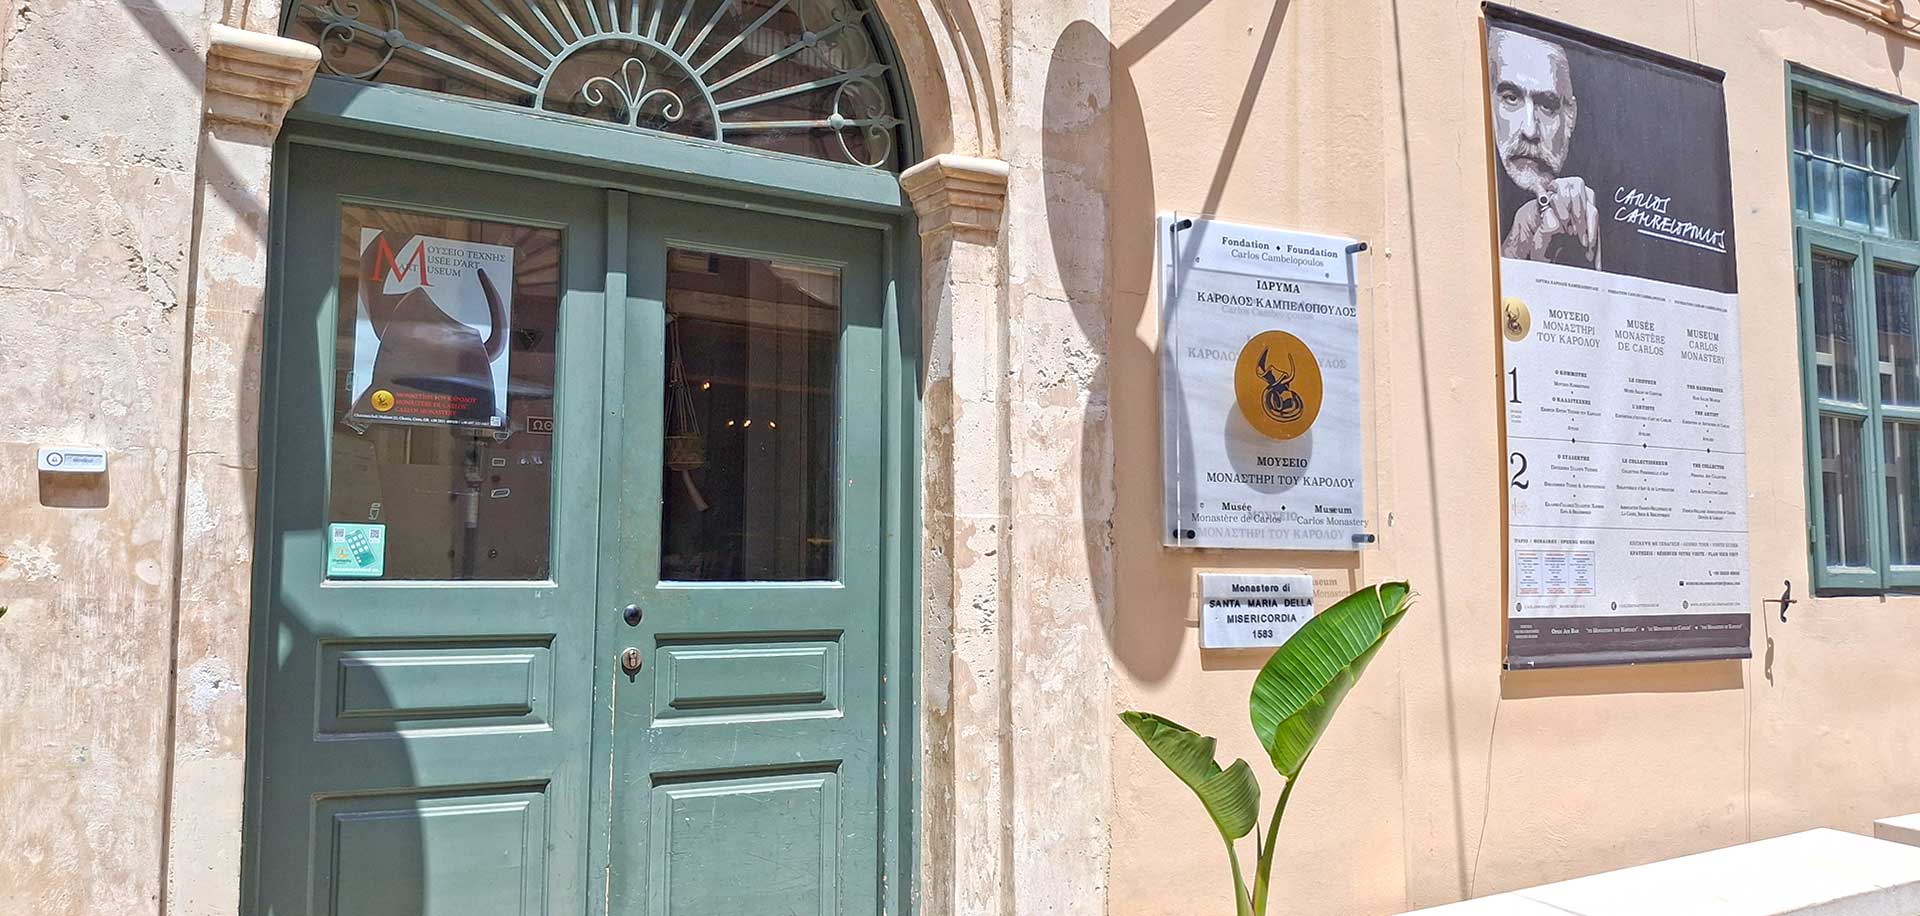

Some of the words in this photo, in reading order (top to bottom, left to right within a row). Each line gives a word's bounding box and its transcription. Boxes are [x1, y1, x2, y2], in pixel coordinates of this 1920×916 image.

[1222, 237, 1270, 250] Fondation
[1287, 244, 1338, 259] Foundation
[467, 250, 507, 263] ΤΕΧΝΗΣ
[1231, 249, 1259, 261] Carlos
[1261, 252, 1324, 268] Cambelopoulos
[1256, 280, 1301, 294] ΙΔΡΥΜΑ
[1197, 291, 1253, 307] ΚΑΡΟΛΟΣ
[1256, 298, 1357, 317] ΚΑΜΠΕΛΟΠΟΥΛΟΣ
[1548, 309, 1590, 322] ΜΟΥΣΕΙΟ
[1542, 320, 1595, 336] ΜΟΝΑΣΤΗΡΙ
[1626, 319, 1655, 331] MUSÉE
[1536, 331, 1557, 343] ΤΟΥ
[1559, 334, 1601, 348] ΚΑΡΟΛΟΥ
[1614, 329, 1666, 344] MONASTÈRE
[1686, 328, 1719, 341] MUSEUM
[1617, 341, 1630, 351] DE
[1632, 343, 1664, 356] CARLOS
[1688, 340, 1718, 352] CARLOS
[1681, 350, 1726, 365] MONASTERY
[1508, 367, 1522, 404] 1
[1257, 456, 1308, 468] ΜΟΥΣΕΙΟ
[1510, 452, 1529, 490] 2
[1206, 472, 1275, 485] ΜΟΝΑΣΤΗΡΙ
[1278, 476, 1300, 486] ΤΟΥ
[1303, 477, 1354, 488] ΚΑΡΟΛΟΥ
[1222, 502, 1252, 512] Musée
[1314, 505, 1353, 514] Museum
[1191, 512, 1239, 523] Monastère
[1240, 514, 1251, 523] de
[1253, 514, 1282, 524] Carlos
[1297, 515, 1324, 526] Carlos
[1326, 516, 1369, 528] Monastery
[1232, 583, 1279, 593] Monastero
[1282, 583, 1291, 592] di
[1209, 599, 1241, 608] SANTA
[1247, 599, 1278, 608] MARIA
[1284, 599, 1312, 607] DELLA
[1227, 614, 1297, 624] MISERICORDIA
[1252, 630, 1273, 639] 1583
